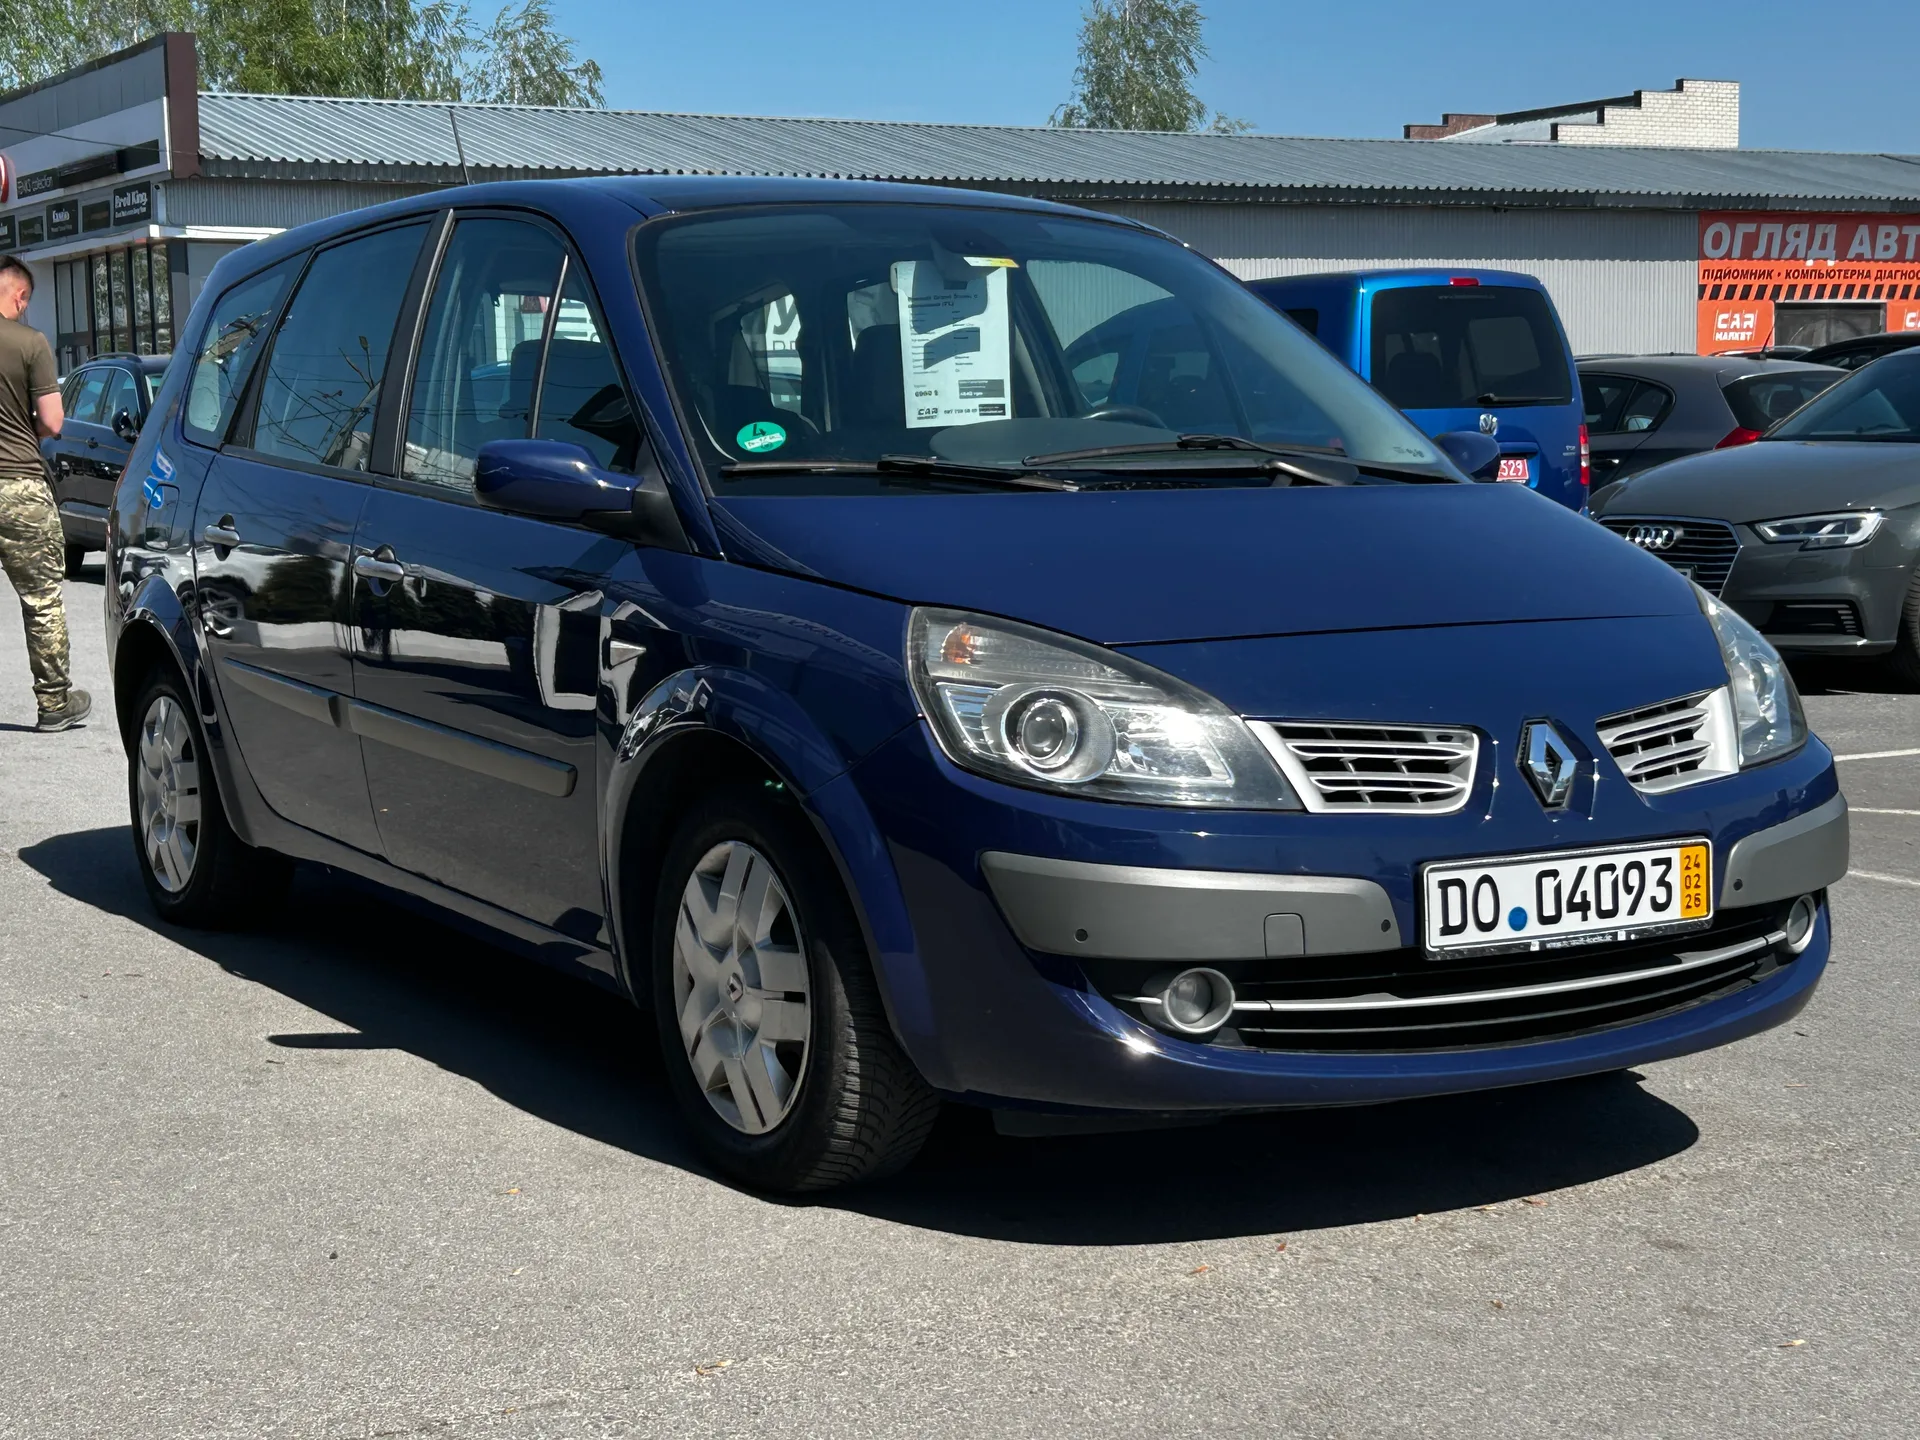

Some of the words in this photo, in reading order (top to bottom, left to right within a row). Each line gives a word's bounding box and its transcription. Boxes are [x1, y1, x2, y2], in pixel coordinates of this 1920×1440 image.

[1703, 222, 1837, 266] ОГЛЯД
[1846, 224, 1920, 259] АВТ
[1702, 267, 1774, 281] ПІДЙОМНИК
[1717, 313, 1754, 329] CAR
[1715, 331, 1752, 341] MARKET
[1684, 854, 1701, 870] 24
[1684, 873, 1702, 890] 02
[1437, 874, 1501, 936] DO
[1536, 857, 1673, 926] 04093
